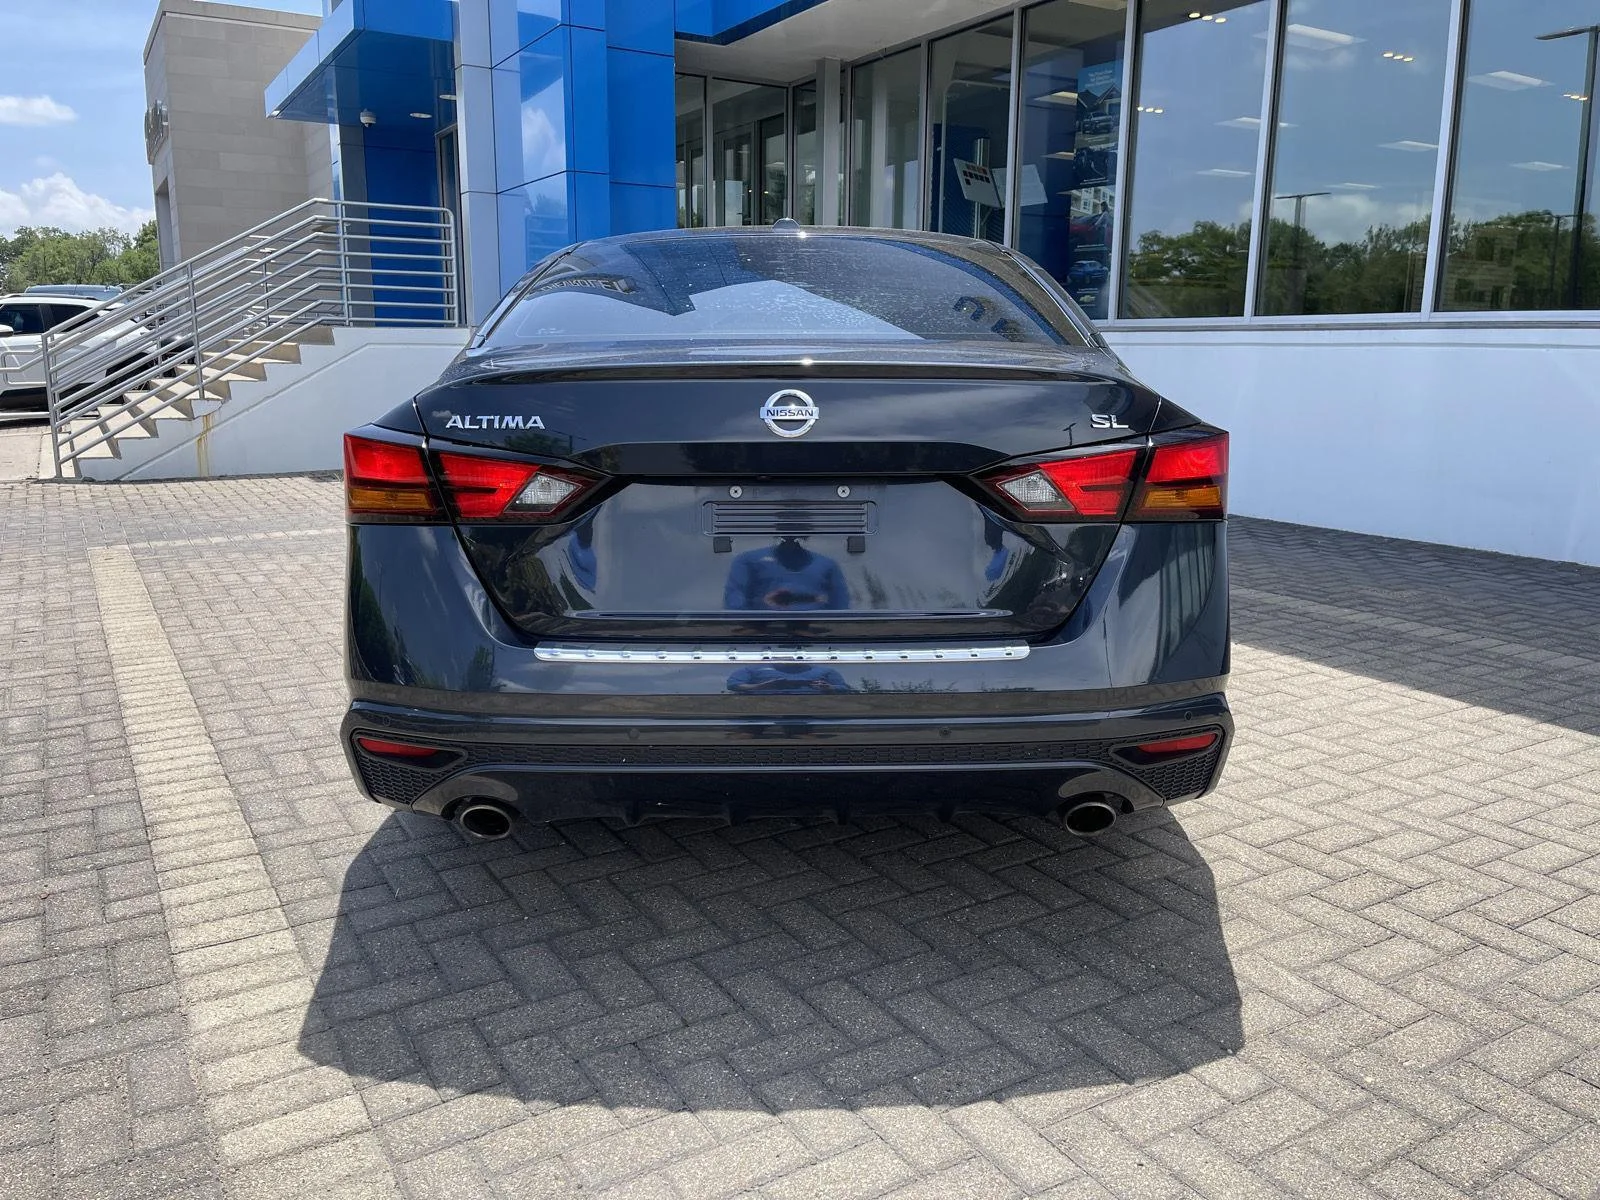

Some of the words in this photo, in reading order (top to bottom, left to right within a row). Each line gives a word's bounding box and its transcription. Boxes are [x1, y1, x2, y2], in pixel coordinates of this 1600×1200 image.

[766, 409, 814, 417] NISSAN
[445, 415, 545, 429] ALTIMA
[1091, 414, 1129, 428] SL
